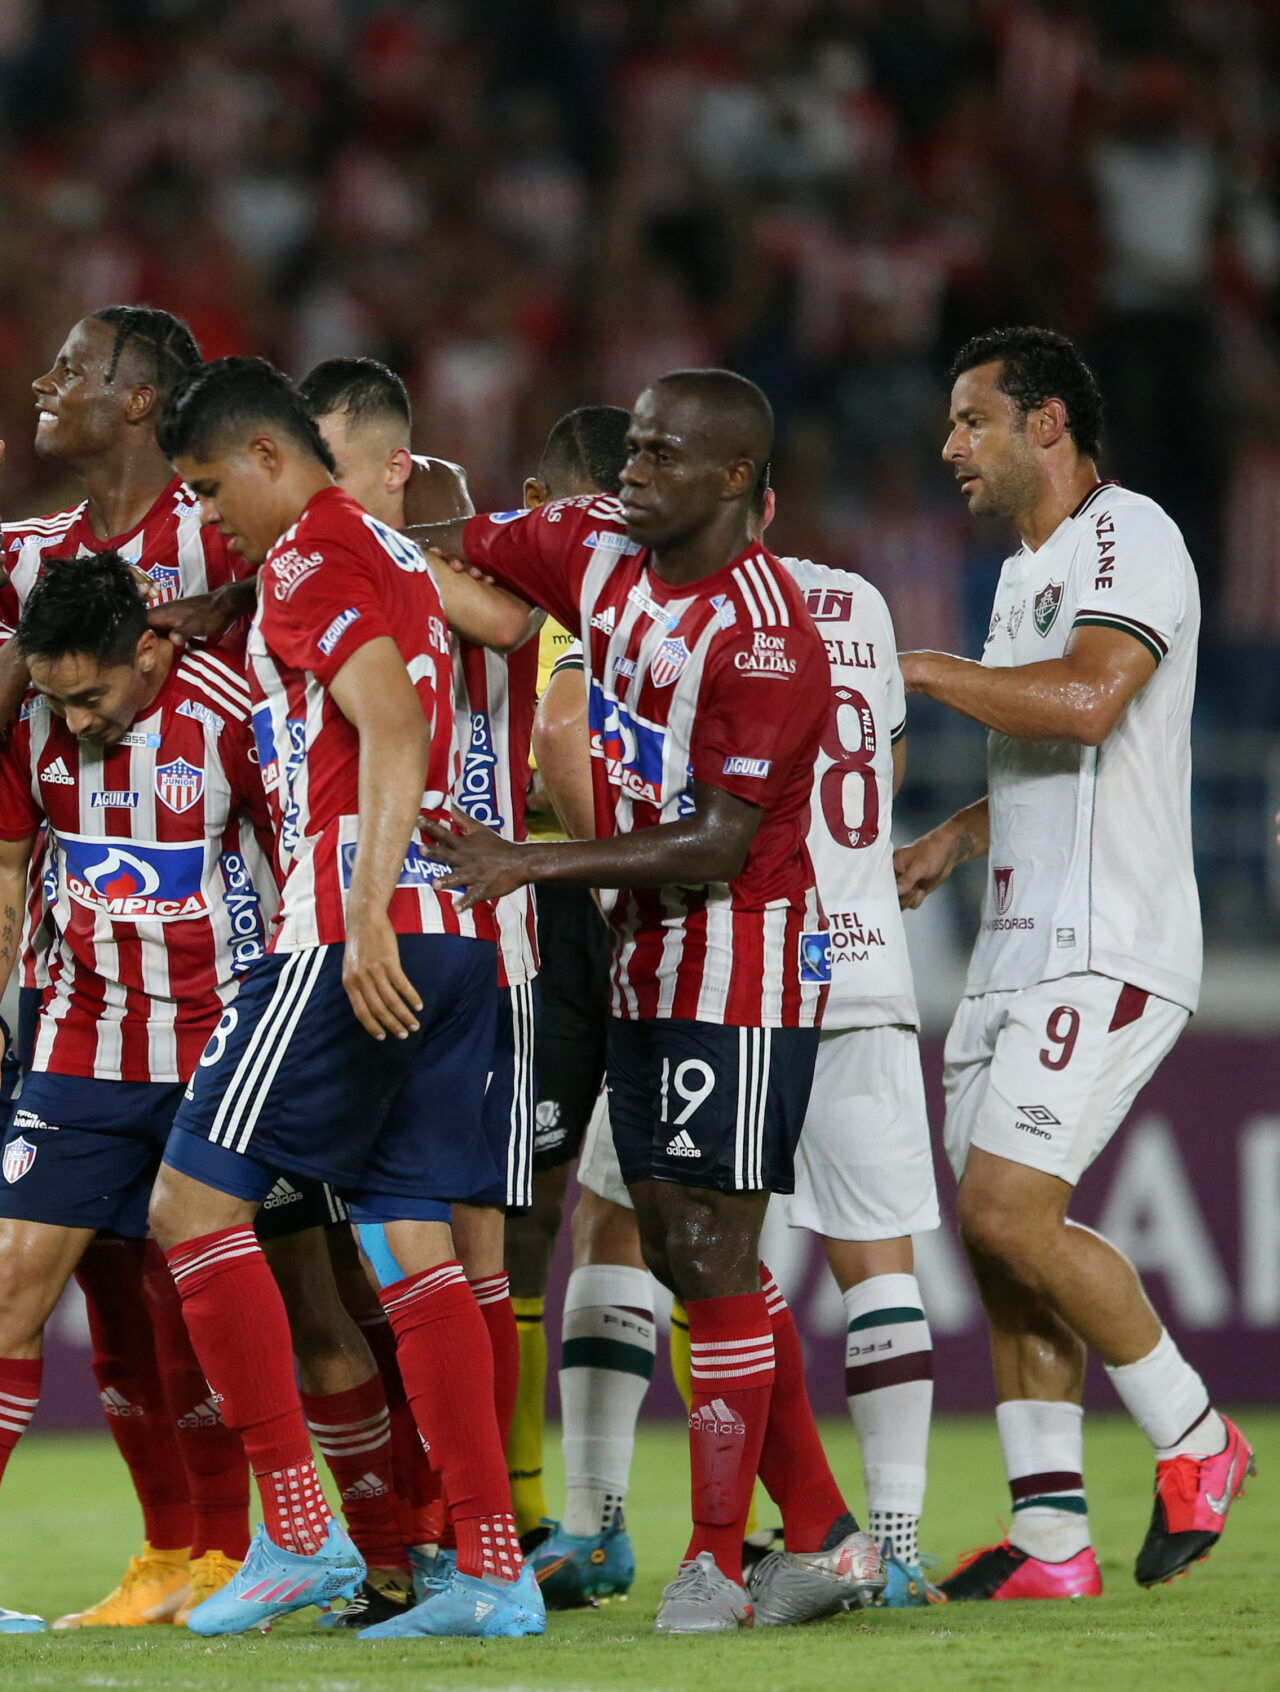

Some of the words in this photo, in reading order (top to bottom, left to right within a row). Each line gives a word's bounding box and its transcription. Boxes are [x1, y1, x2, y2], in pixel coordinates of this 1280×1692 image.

[1090, 511, 1115, 591] NZANE
[753, 632, 786, 650] RON
[734, 652, 797, 674] CALDAS
[726, 758, 770, 777] AGUILA
[802, 685, 880, 849] 8
[40, 772, 75, 785] adidas
[163, 778, 195, 786] JUNIOR
[93, 793, 136, 807] AGUILA
[225, 856, 264, 971] play.co
[830, 912, 863, 930] TEL
[832, 928, 886, 948] ONAL
[1039, 1005, 1081, 1071] 9
[660, 1058, 716, 1125] 19
[1015, 1121, 1052, 1141] umbro
[666, 1146, 701, 1158] adidas
[264, 1192, 303, 1209] adidas
[604, 1314, 650, 1338] FFC
